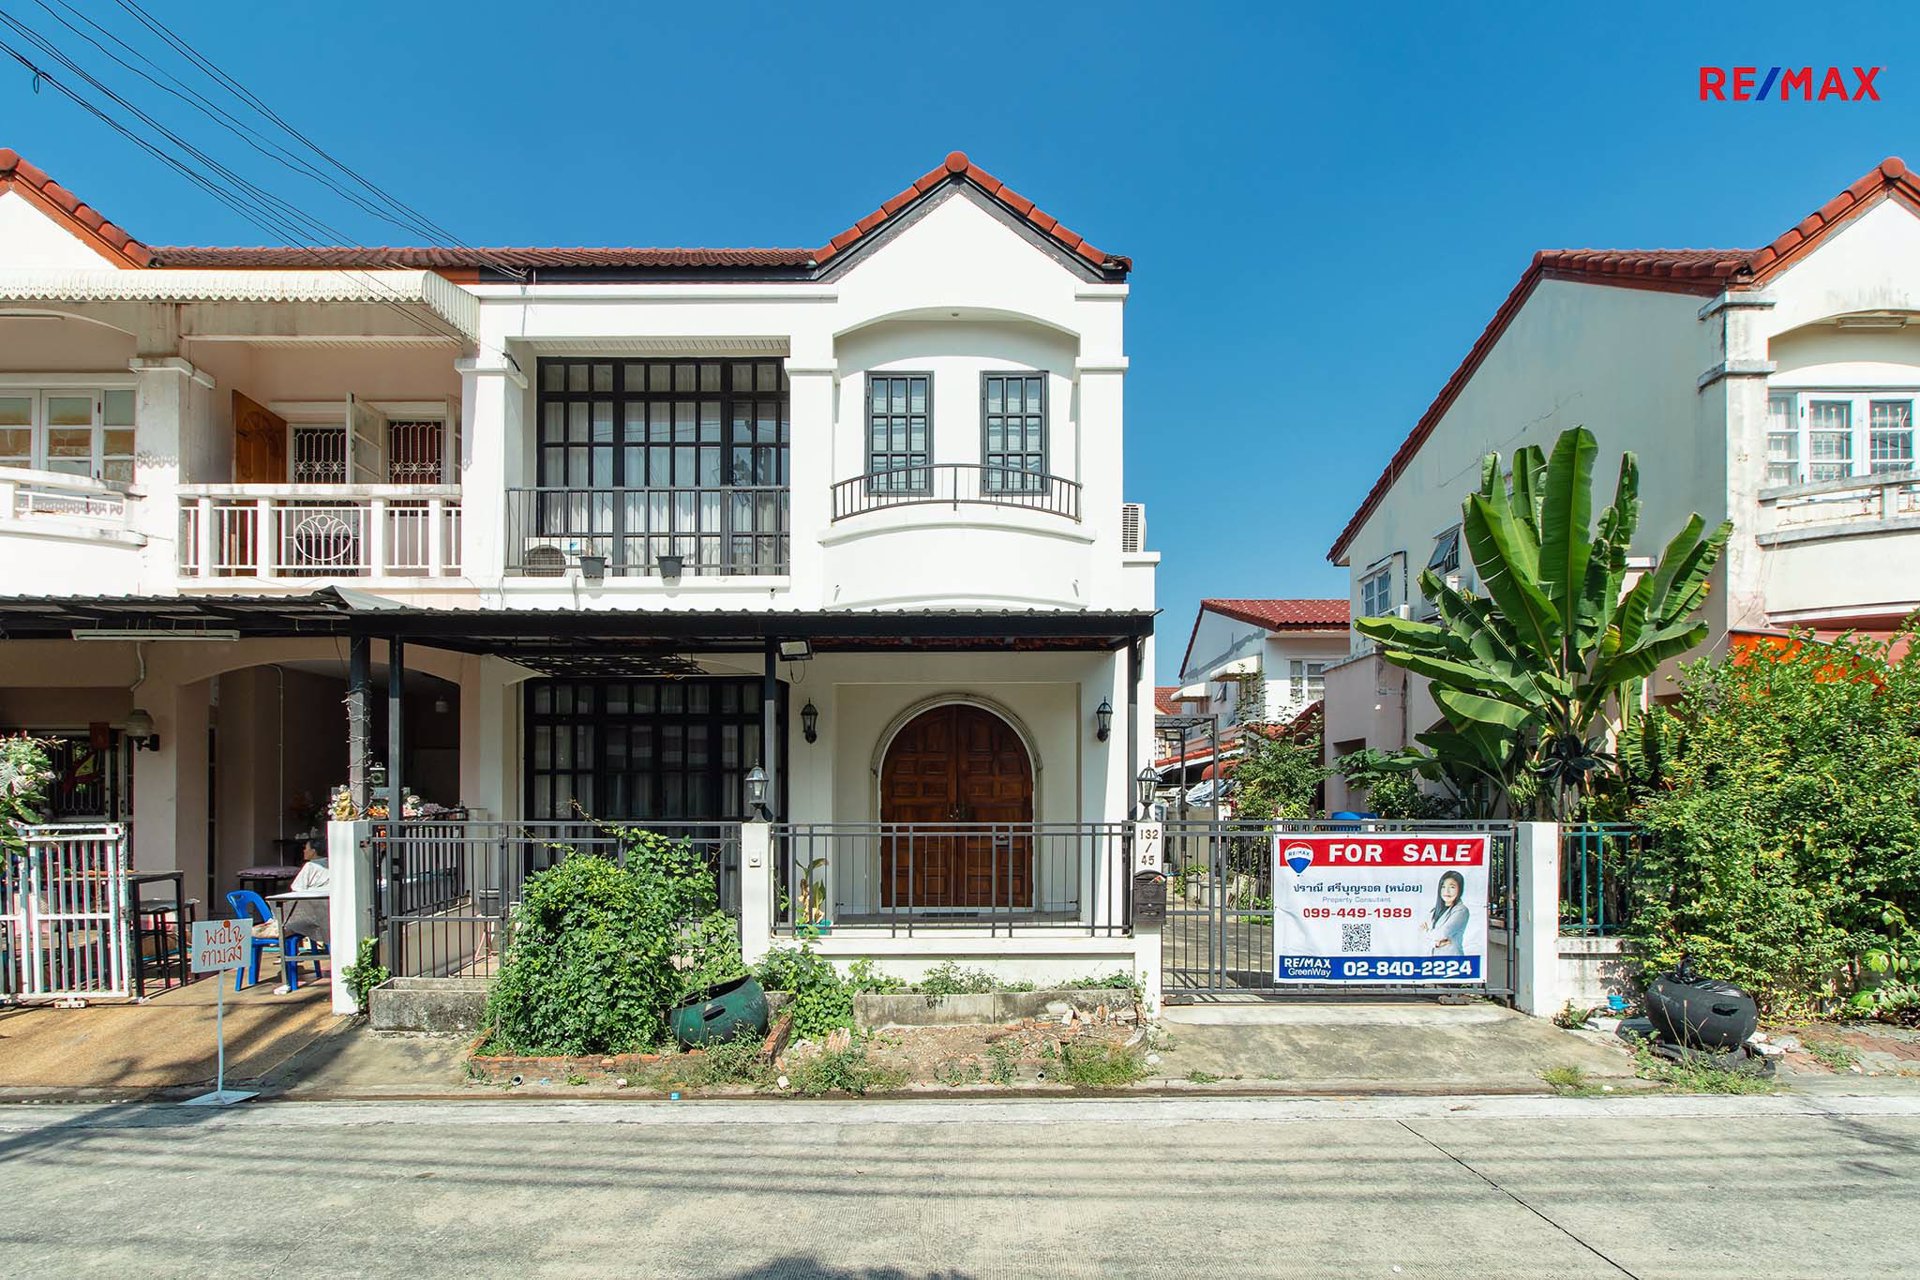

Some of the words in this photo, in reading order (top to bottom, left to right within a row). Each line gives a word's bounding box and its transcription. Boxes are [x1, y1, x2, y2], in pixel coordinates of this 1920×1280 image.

[1140, 829, 1158, 839] 132
[1328, 844, 1383, 862] FOR
[1402, 844, 1471, 862] SALE
[1141, 855, 1154, 865] 45
[1293, 882, 1323, 893] ปราณี
[1327, 882, 1381, 896] ศรีบุญรอด
[1385, 882, 1423, 894] (หน่อย)
[1322, 896, 1352, 904] Property
[1303, 908, 1412, 918] 099-449-1989
[1284, 958, 1331, 968] RE/MAX
[1343, 960, 1472, 978] 02-840-2224
[1288, 967, 1332, 978] GreenWay
